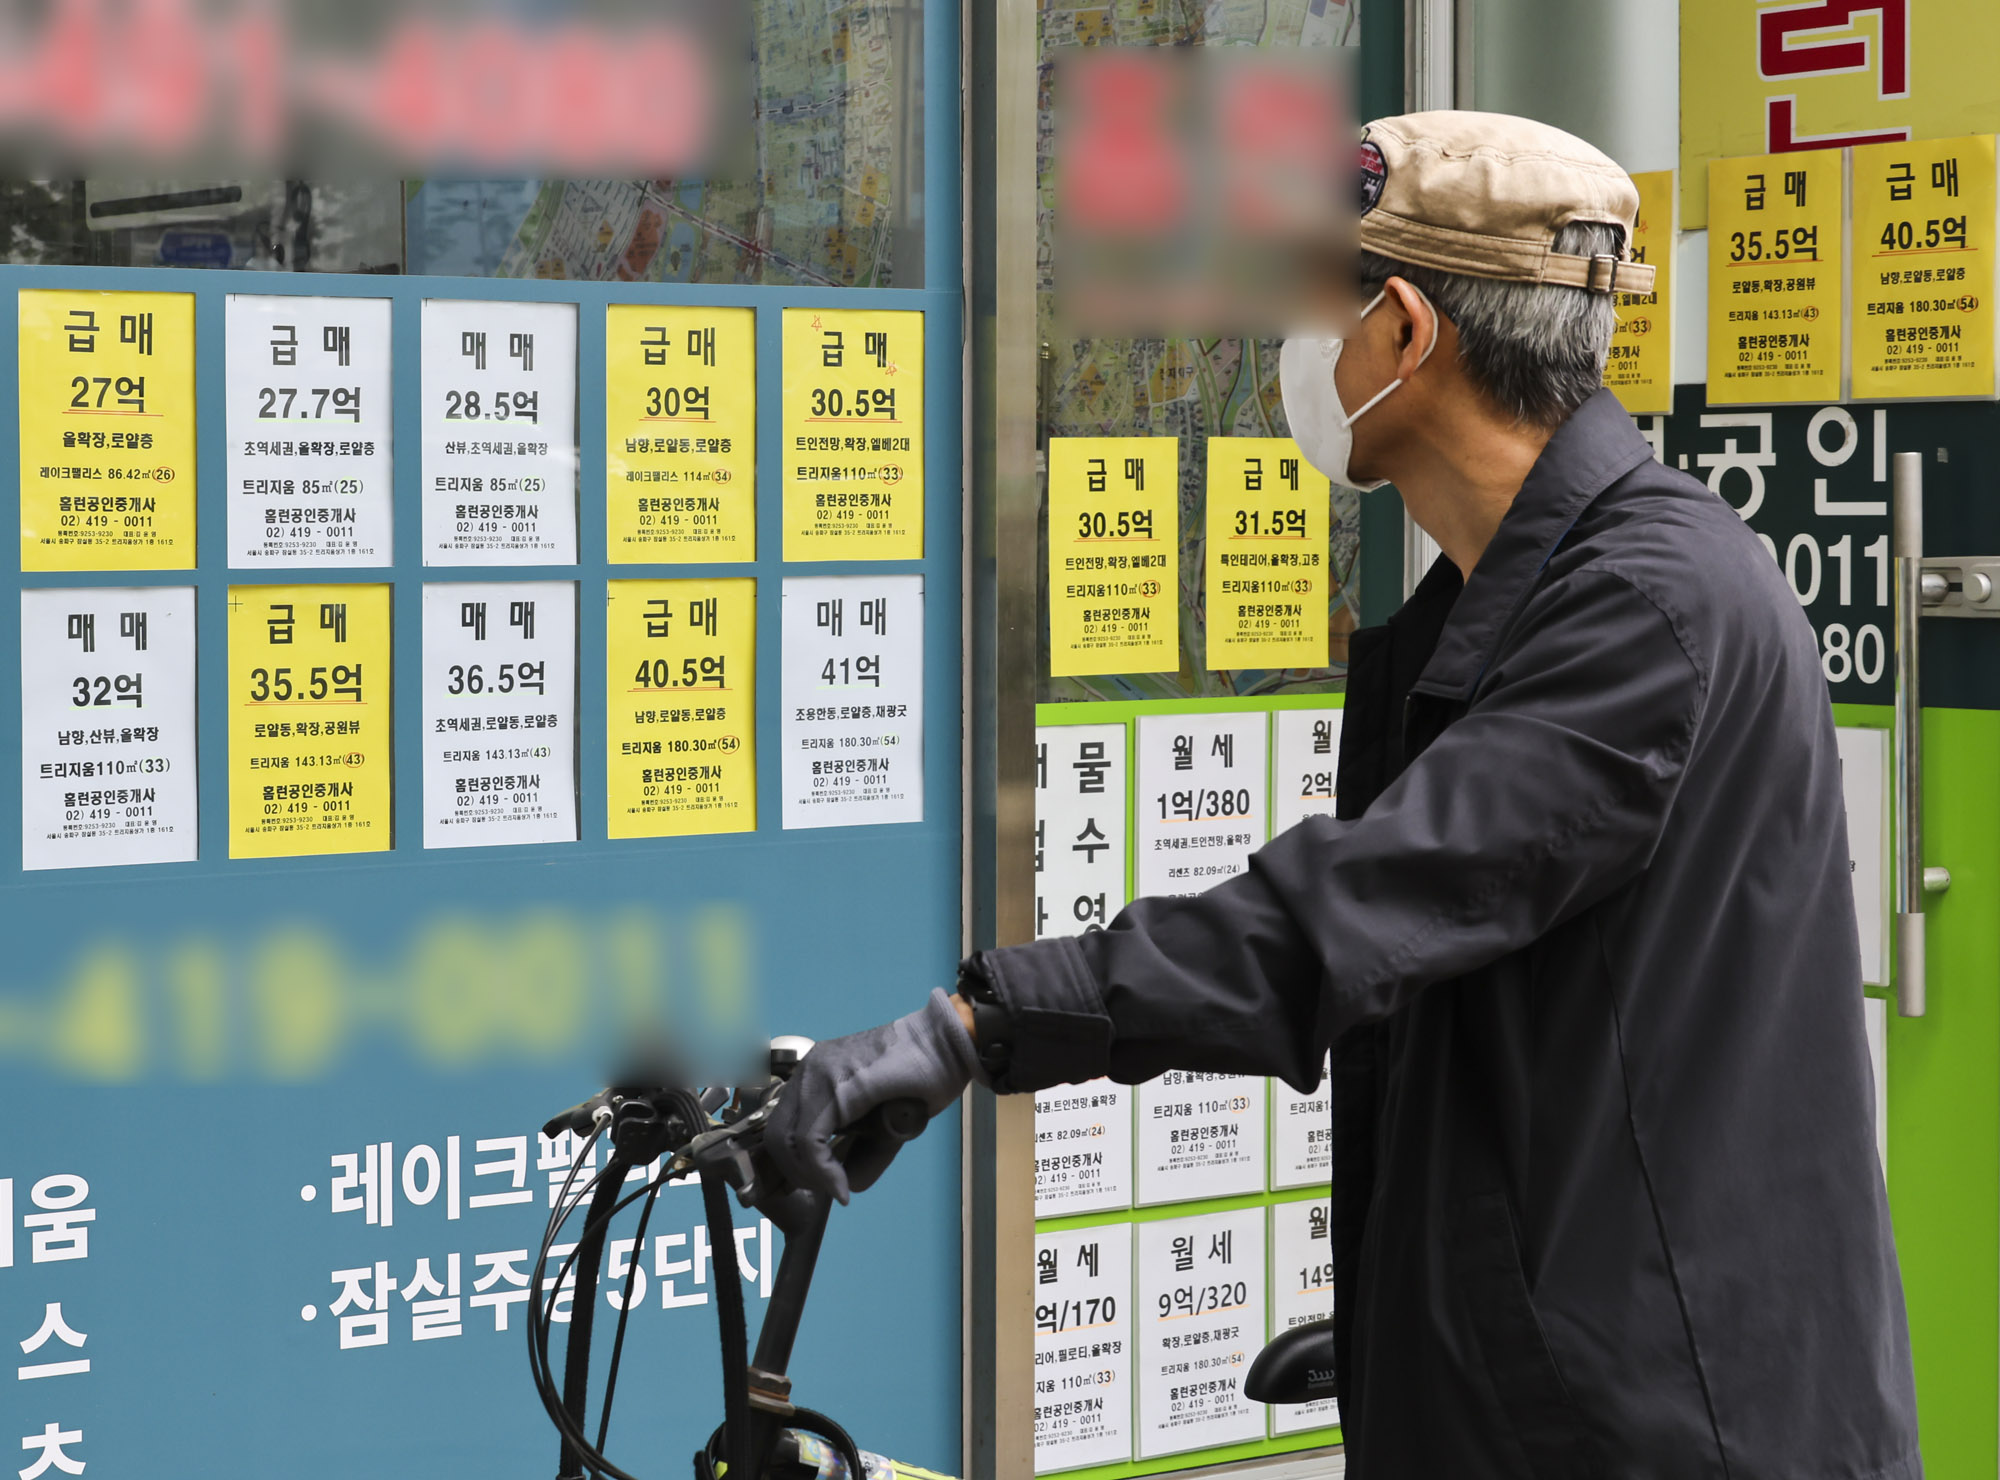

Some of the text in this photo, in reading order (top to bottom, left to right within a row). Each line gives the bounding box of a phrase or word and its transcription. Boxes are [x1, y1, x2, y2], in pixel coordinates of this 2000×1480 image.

[1886, 158, 1958, 201] 급 매
[1744, 171, 1806, 211] 급 매
[1880, 215, 1966, 250] 40.5억
[1730, 225, 1817, 262] 35.5억
[1732, 277, 1815, 294] 로얄동,확장,공원뷰
[1880, 267, 1965, 285] 남향,로얄동,로얄층
[1728, 310, 1759, 322] 트리지움
[1867, 301, 1904, 315] 트리지움
[64, 310, 153, 356] 급 매
[1738, 333, 1810, 350] 홈런공인중개사
[1885, 325, 1961, 342] 홈런공인중개사
[270, 325, 350, 366] 급 매
[462, 331, 533, 371] 매 매
[640, 327, 715, 367] 급 매
[821, 331, 887, 368] 급 매
[1887, 342, 1958, 355] 02) 419 0011
[1618, 361, 1637, 370] 0011
[71, 376, 145, 413] 27억
[646, 386, 709, 420] 30억
[811, 388, 895, 420] 30.5억
[259, 387, 361, 423] 27.7억
[446, 390, 538, 424] 28.5억
[62, 431, 153, 449] 올확장,로얄층
[244, 441, 375, 456] 초역세권,올확장,로얄층
[445, 441, 548, 456] 산뷰,초역세권,올확장
[625, 438, 732, 453] 남향,로얄동,로얄층
[796, 437, 910, 451] 트인전망,확장,엘베2대
[435, 477, 483, 492] 트리지움
[1087, 458, 1144, 492] 급 매
[1244, 458, 1298, 491] 급 매
[243, 479, 295, 495] 트리지움
[59, 496, 156, 513] 홈런공인중개사
[638, 497, 720, 512] 홈런공인중개사
[816, 493, 892, 507] 홈런공인중개사
[61, 515, 152, 527] 02) 419 0011
[265, 508, 356, 524] 홈런공인중개사
[455, 504, 539, 519] 홈런공인중개사
[1079, 509, 1153, 539] 30.5억
[1235, 509, 1306, 538] 31.5억
[1065, 554, 1166, 570] 트인전망,확장,엘베2대
[643, 597, 717, 638] 급 매
[817, 598, 886, 637] 매 매
[1083, 607, 1150, 622] 홈런공인중개사
[1238, 604, 1302, 617] 홈런공인중개사
[267, 603, 346, 644] 급 매
[461, 601, 535, 641] 매 매
[68, 612, 147, 653] 매 매
[448, 661, 545, 695] 36.5억
[635, 655, 725, 689] 40.5억
[821, 655, 880, 687] 41억
[72, 673, 142, 708] 32억
[251, 664, 362, 702] 35.5억
[635, 707, 726, 724] 남향,로얄동,로얄층
[795, 704, 907, 721] 조용한동,로얄층,채광굿
[255, 720, 360, 738] 로얄동,확장,공원뷰
[435, 714, 558, 733] 초역세권,로얄동,로얄층
[58, 726, 159, 746] 남향,산뷰,올확장
[801, 738, 834, 750] 트리지움
[1312, 720, 1332, 754] 월
[443, 750, 480, 762] 트리지움
[622, 741, 662, 755] 트리지움
[1172, 734, 1233, 771] 월 세
[250, 757, 290, 769] 트리지움
[812, 757, 889, 775] 홈런공인중개사
[1073, 742, 1111, 794] 물
[455, 774, 540, 793] 홈런공인중개사
[642, 765, 722, 783] 홈런공인중개사
[64, 787, 156, 807] 홈런공인중개사
[263, 782, 353, 801] 홈런공인중개사
[1157, 789, 1250, 821] 1억/380
[1072, 818, 1110, 864] 수
[1153, 1103, 1193, 1119] 트리지움
[1170, 1123, 1239, 1143] 홈런공인중개사
[1050, 1168, 1100, 1183] 419 0011
[1171, 1230, 1232, 1272] 월 세
[1037, 1243, 1098, 1285] 월 세
[1159, 1281, 1246, 1318] 9억/320
[1161, 1362, 1190, 1376] 트리지움
[1170, 1378, 1237, 1400] 홈런공인중개사
